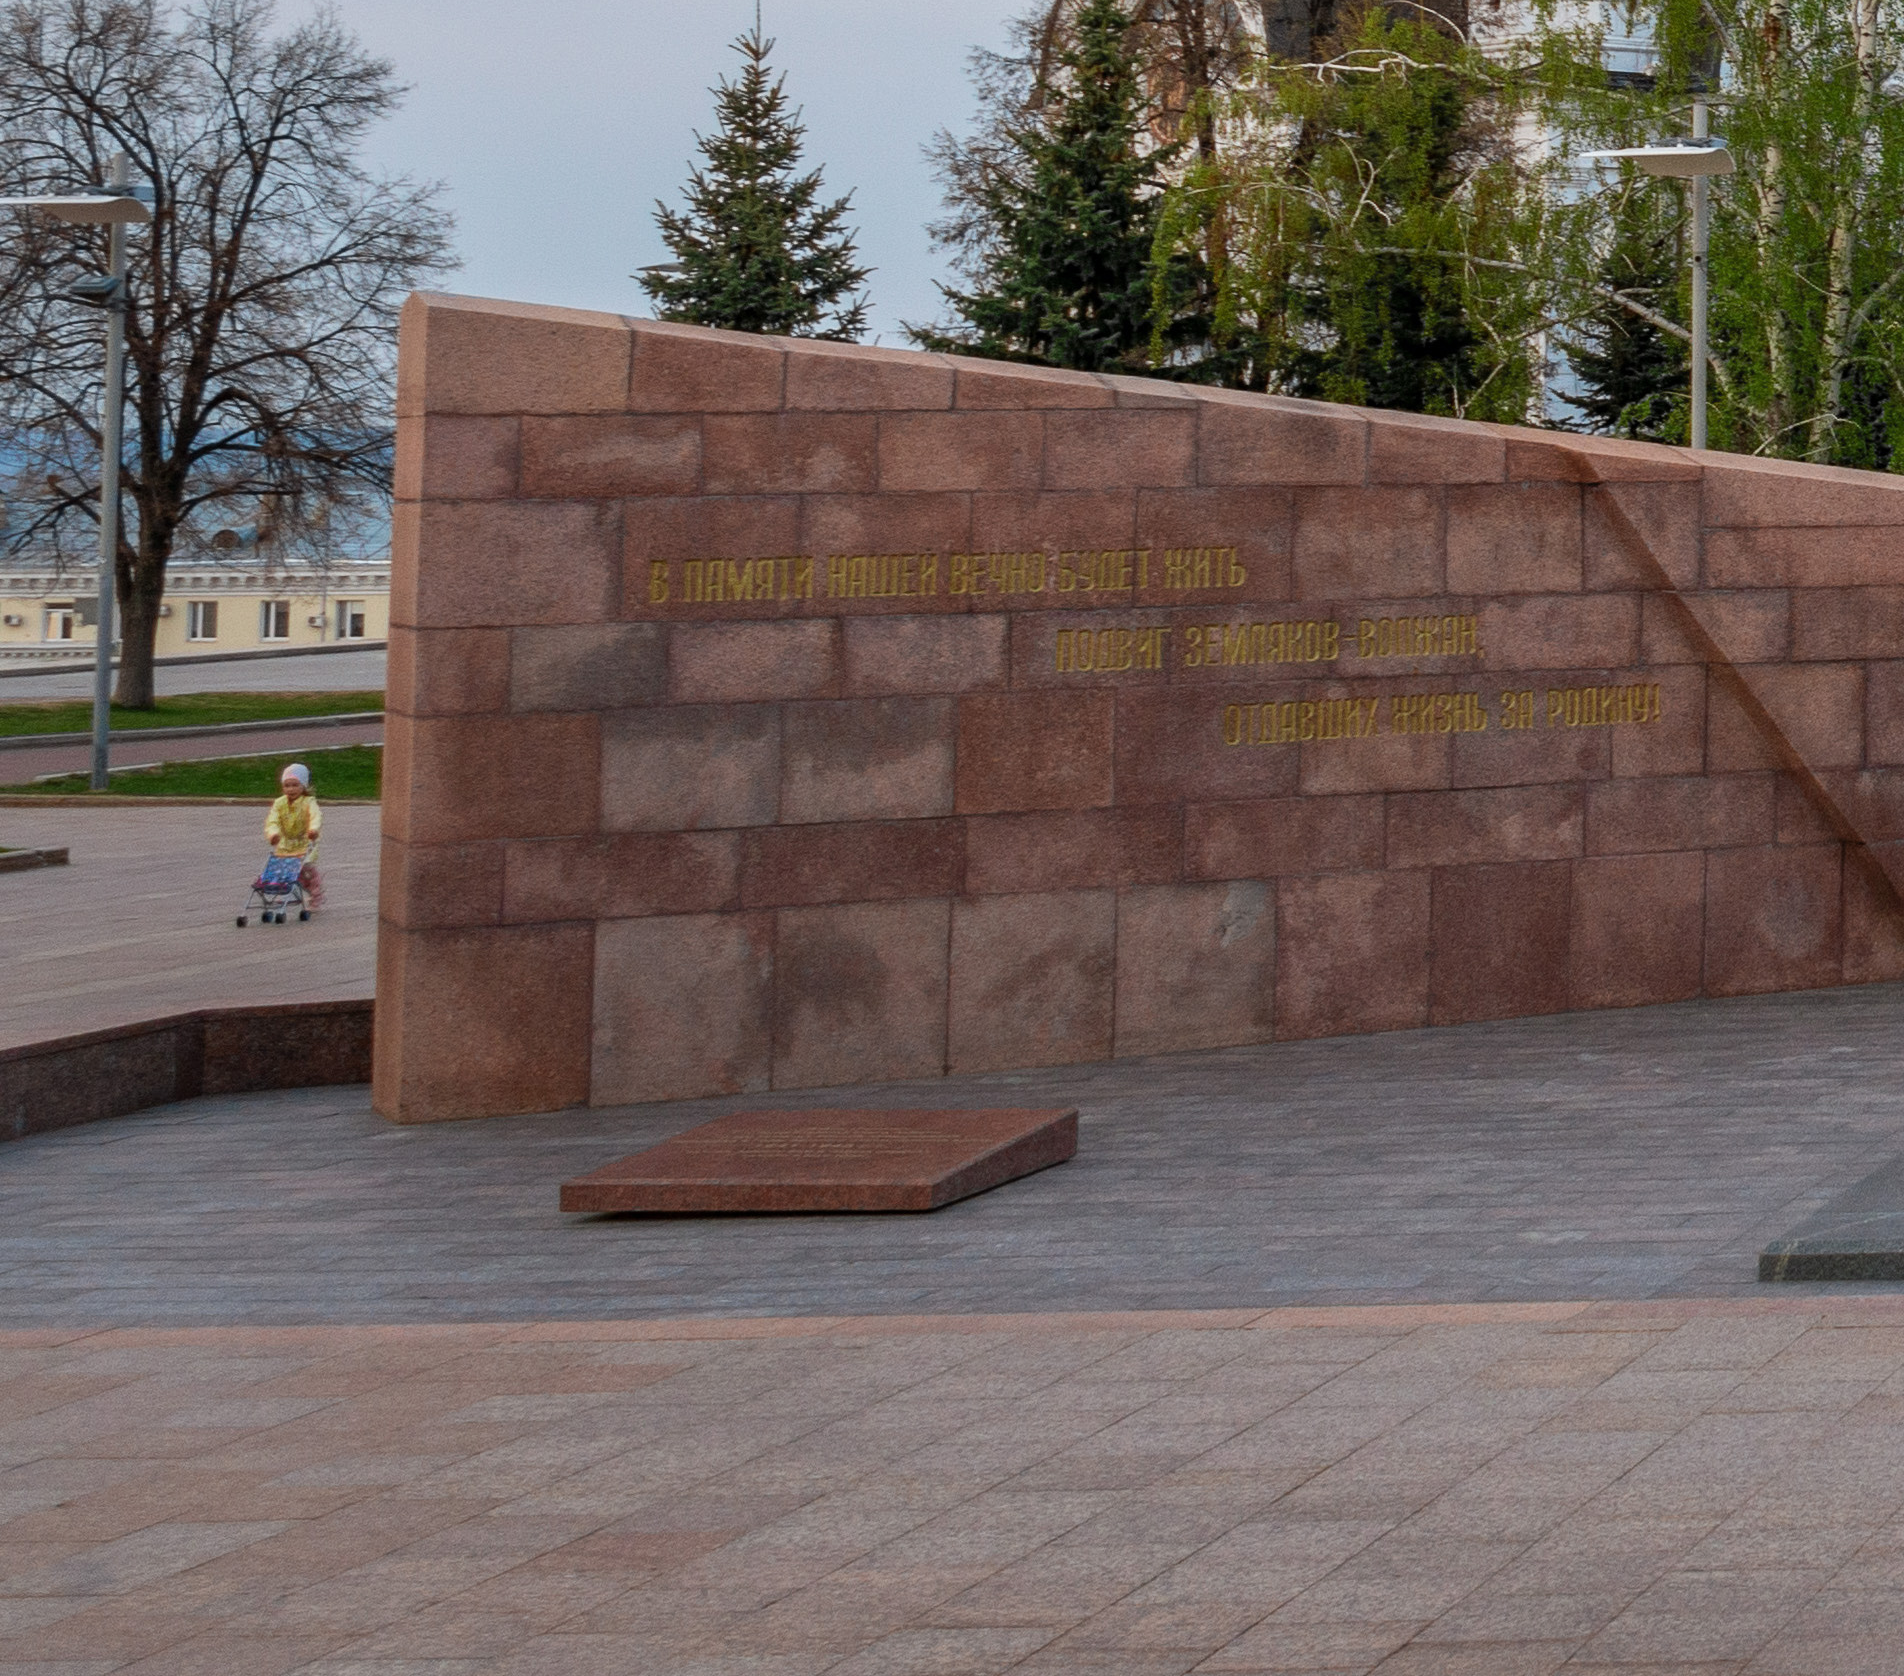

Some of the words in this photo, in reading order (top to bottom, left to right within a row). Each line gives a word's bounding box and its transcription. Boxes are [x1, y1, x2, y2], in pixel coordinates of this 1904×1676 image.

[648, 560, 670, 603] В
[683, 556, 815, 601] ПАМЯТИ
[826, 550, 938, 596] НАШЕЙ
[948, 551, 1046, 594] ВЕЧНО
[1057, 549, 1152, 592] БУДЕТ
[1164, 547, 1247, 588] ЖИТЬ
[1056, 627, 1171, 672] ПОДВИГ
[1223, 697, 1380, 745] ОТДАВШИХ
[1392, 692, 1488, 733] ЖИЗНЬ
[1500, 691, 1535, 730] ЗА
[1547, 684, 1661, 728] РОДИНУ!
